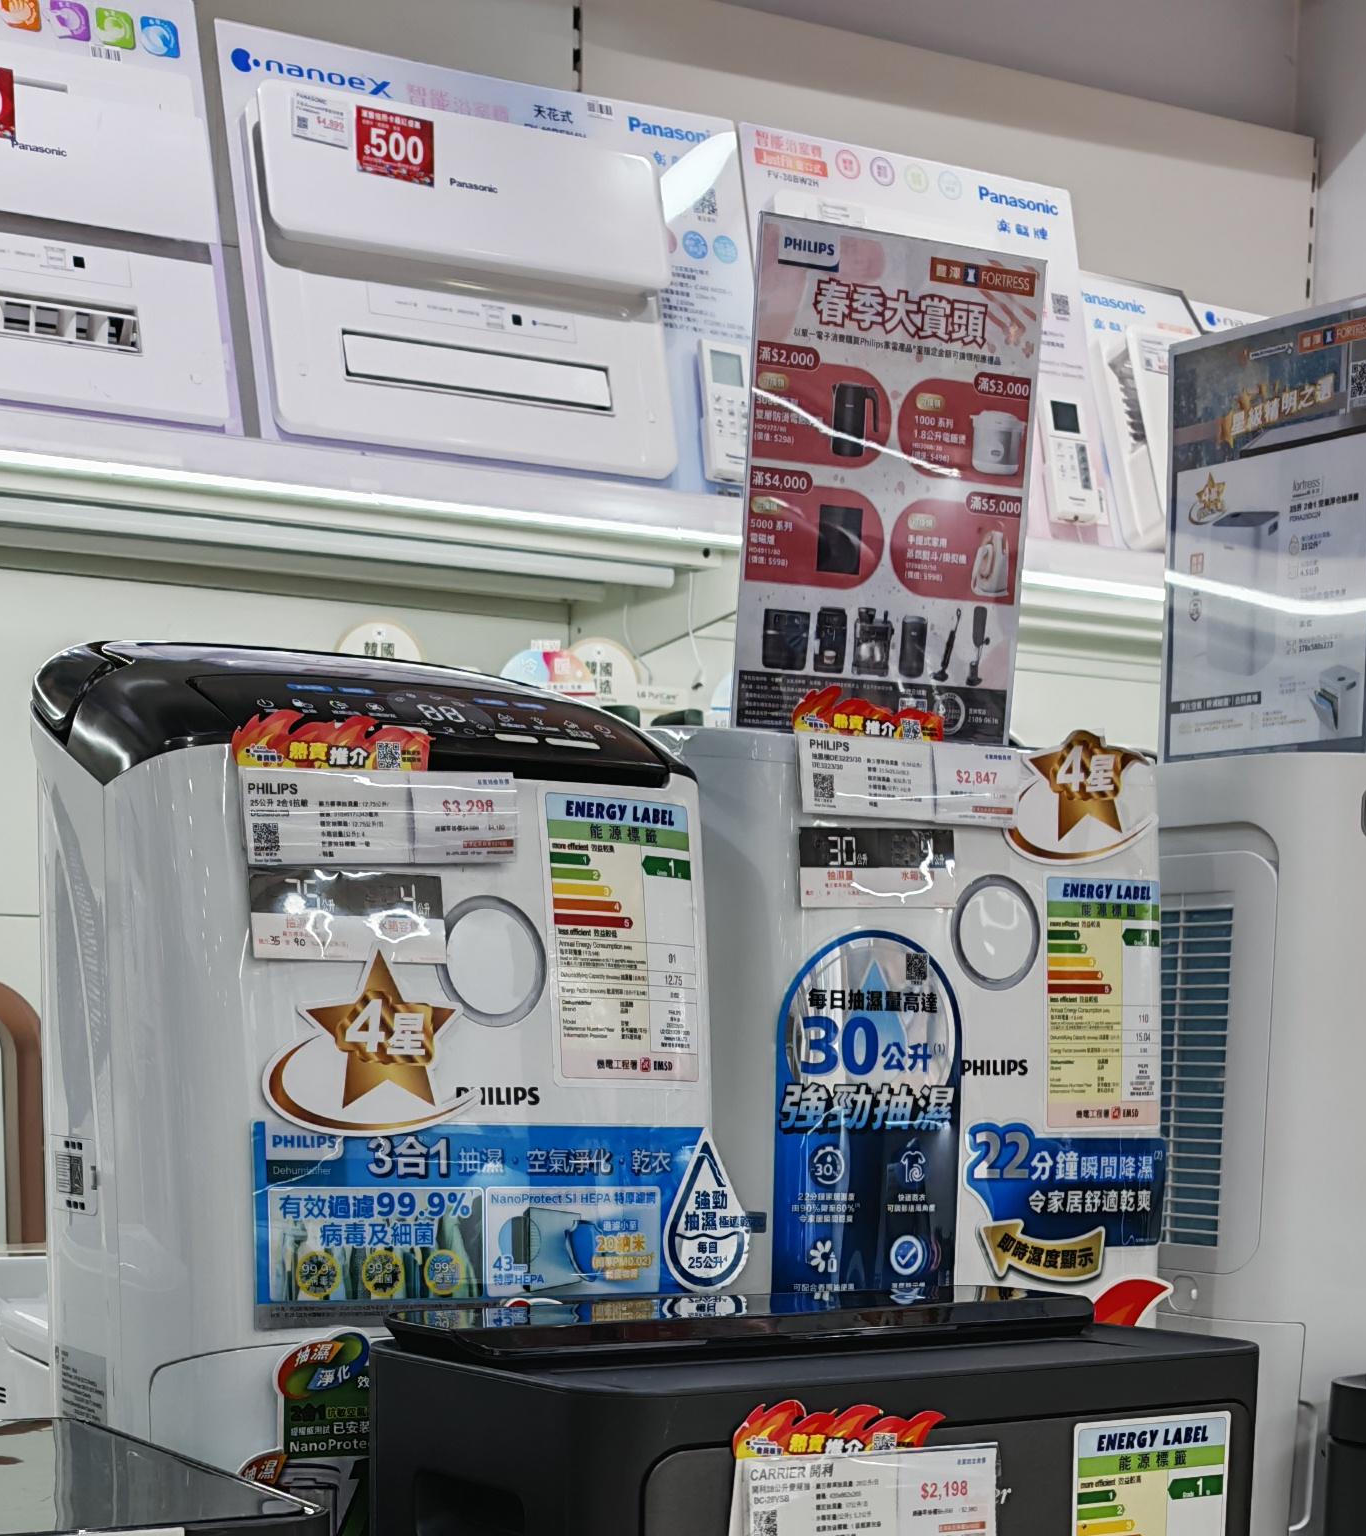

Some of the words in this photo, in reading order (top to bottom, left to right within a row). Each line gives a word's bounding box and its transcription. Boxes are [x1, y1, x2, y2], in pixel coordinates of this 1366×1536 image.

[533, 104, 575, 124] 天花式
[12, 139, 67, 157] Panasonic
[364, 127, 424, 165] $500
[450, 178, 498, 193] Panasonic
[978, 186, 1059, 215] Panasonic
[784, 237, 835, 256] PHILIPS
[982, 272, 1030, 291] FORTRESS
[759, 346, 814, 366] 滿$2,000
[978, 377, 1029, 396] 滿$3,000
[915, 415, 935, 426] 1000
[938, 417, 953, 429] 系列
[752, 469, 807, 490] 滿$4,000
[970, 496, 1021, 514] 滿$5,000
[751, 519, 773, 529] 5000
[776, 521, 792, 531] 系列
[833, 713, 896, 738] 熱賣推介
[289, 742, 369, 767] 熱賣推介
[809, 739, 850, 752] PHILIPS
[956, 770, 997, 785] $2,847
[1055, 746, 1116, 794] 4星
[247, 783, 298, 795] PHILIPS
[442, 800, 494, 816] $3,298
[566, 800, 627, 820] ENERGY
[632, 806, 675, 826] LABEL
[590, 824, 658, 844] 能源標籤
[828, 836, 856, 865] 30
[1063, 883, 1113, 899] ENERGY
[1116, 885, 1151, 900] LABEL
[665, 974, 683, 986] 12.75
[808, 988, 938, 1013] 每日抽濕量高達
[345, 1000, 427, 1058] 4星
[597, 1059, 637, 1070] 機電工程署
[654, 1061, 672, 1070] EMSD
[962, 1060, 1028, 1077] PHILIPS
[780, 1083, 955, 1131] 強勁抽濕
[272, 1135, 336, 1148] PHILIPS
[367, 1136, 449, 1176] 3合1
[459, 1146, 504, 1174] 抽濕
[526, 1149, 612, 1174] 空氣淨化
[631, 1150, 671, 1173] 乾衣
[973, 1131, 1154, 1181] 22分鐘瞬間降濕
[279, 1192, 471, 1219] 有效過濾99.9%
[491, 1193, 562, 1205] NanoProtect
[580, 1194, 611, 1204] HEPA
[695, 1190, 727, 1209] 強勁
[1029, 1190, 1151, 1214] 令家居舒適乾爽
[685, 1211, 717, 1231] 抽濕
[321, 1223, 435, 1247] 病毒及細菌
[997, 1233, 1094, 1269] 即時濕度顯示
[688, 1256, 723, 1268] 25公升
[295, 1343, 331, 1367] 抽濕
[789, 1434, 864, 1455] 熱賣推介
[1097, 1430, 1158, 1452] ENERGY
[1163, 1425, 1208, 1445] LABEL
[1119, 1450, 1187, 1471] 能源標籤
[750, 1466, 806, 1481] CARRIER
[1095, 1479, 1115, 1488] efficient
[921, 1480, 968, 1499] $2,198
